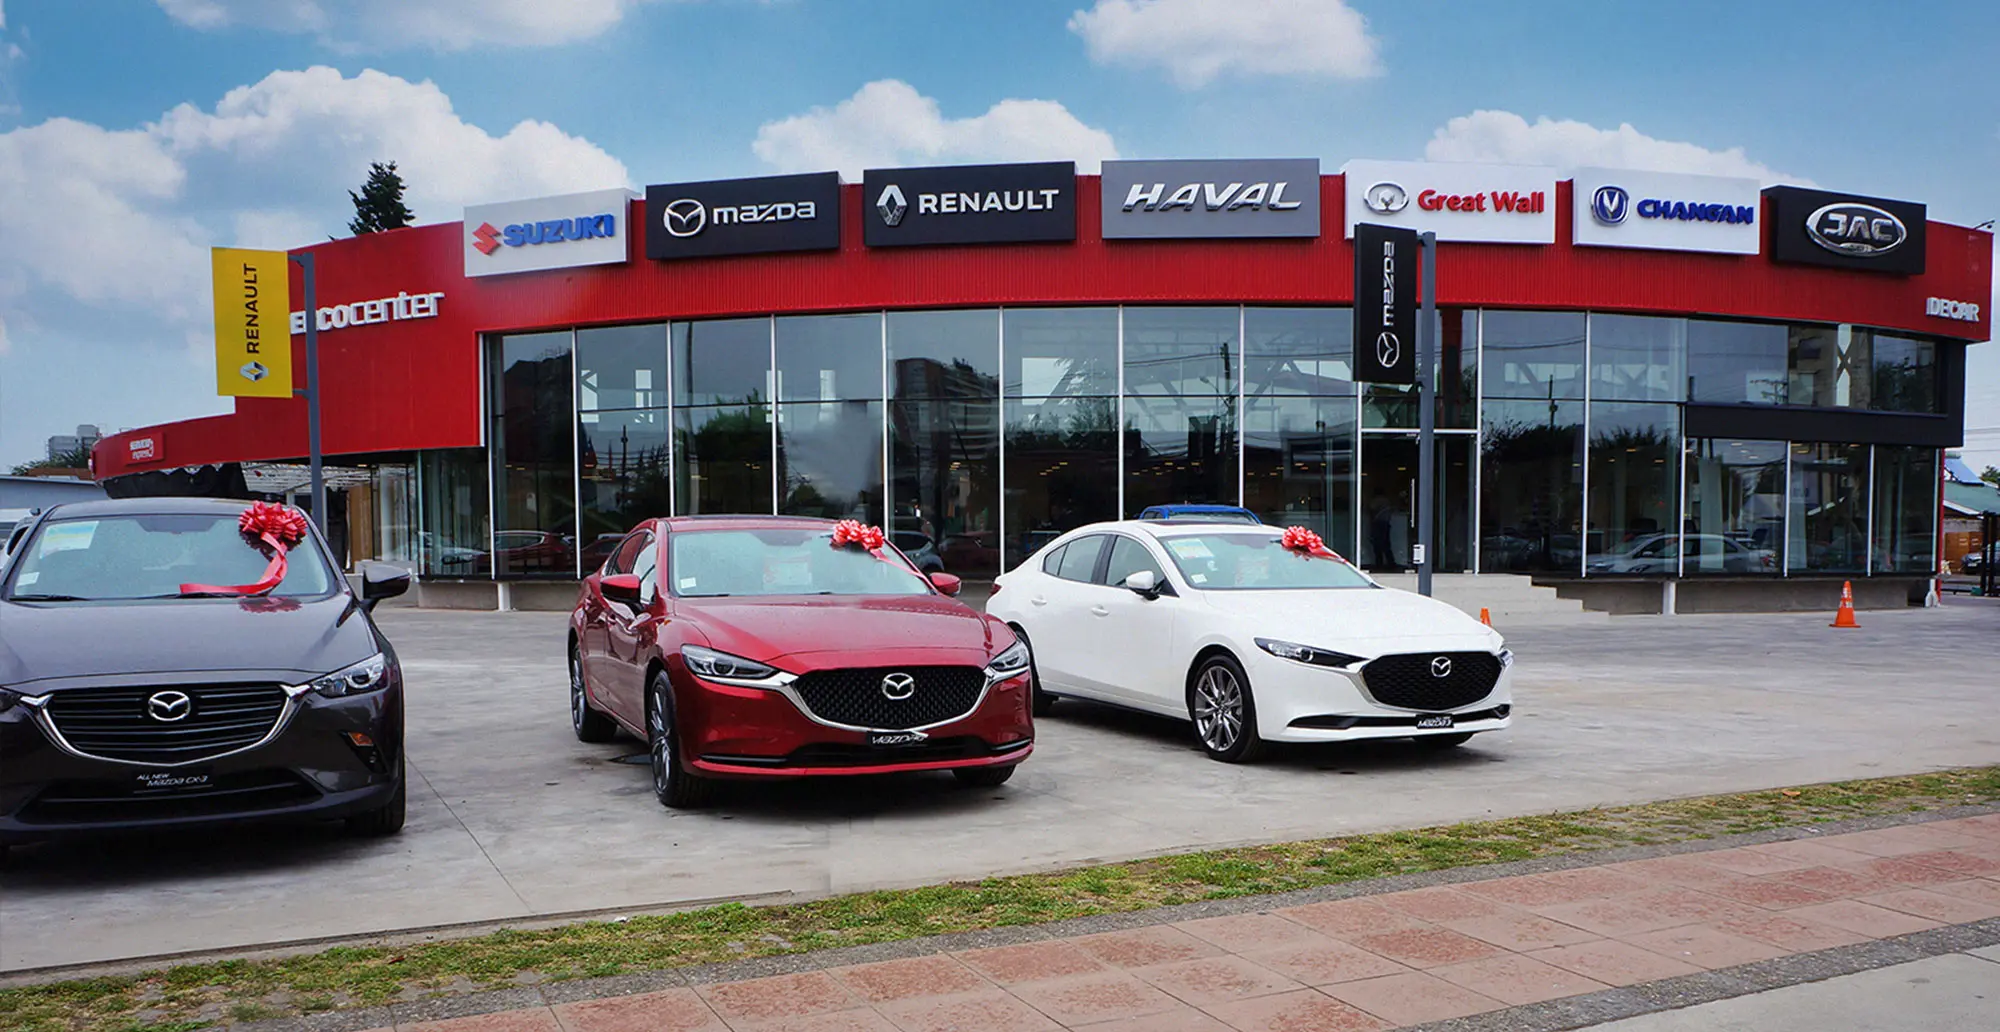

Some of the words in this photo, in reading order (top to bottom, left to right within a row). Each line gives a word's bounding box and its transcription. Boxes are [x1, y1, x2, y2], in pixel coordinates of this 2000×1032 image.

[918, 189, 1060, 214] RENAULT
[1122, 182, 1302, 212] HAVAL
[1417, 189, 1487, 213] Great
[1490, 190, 1545, 214] Wall
[1636, 199, 1754, 224] CHANGAN
[503, 213, 615, 247] SUZUKI
[1823, 212, 1894, 241] JAC
[243, 262, 260, 354] RENAULT
